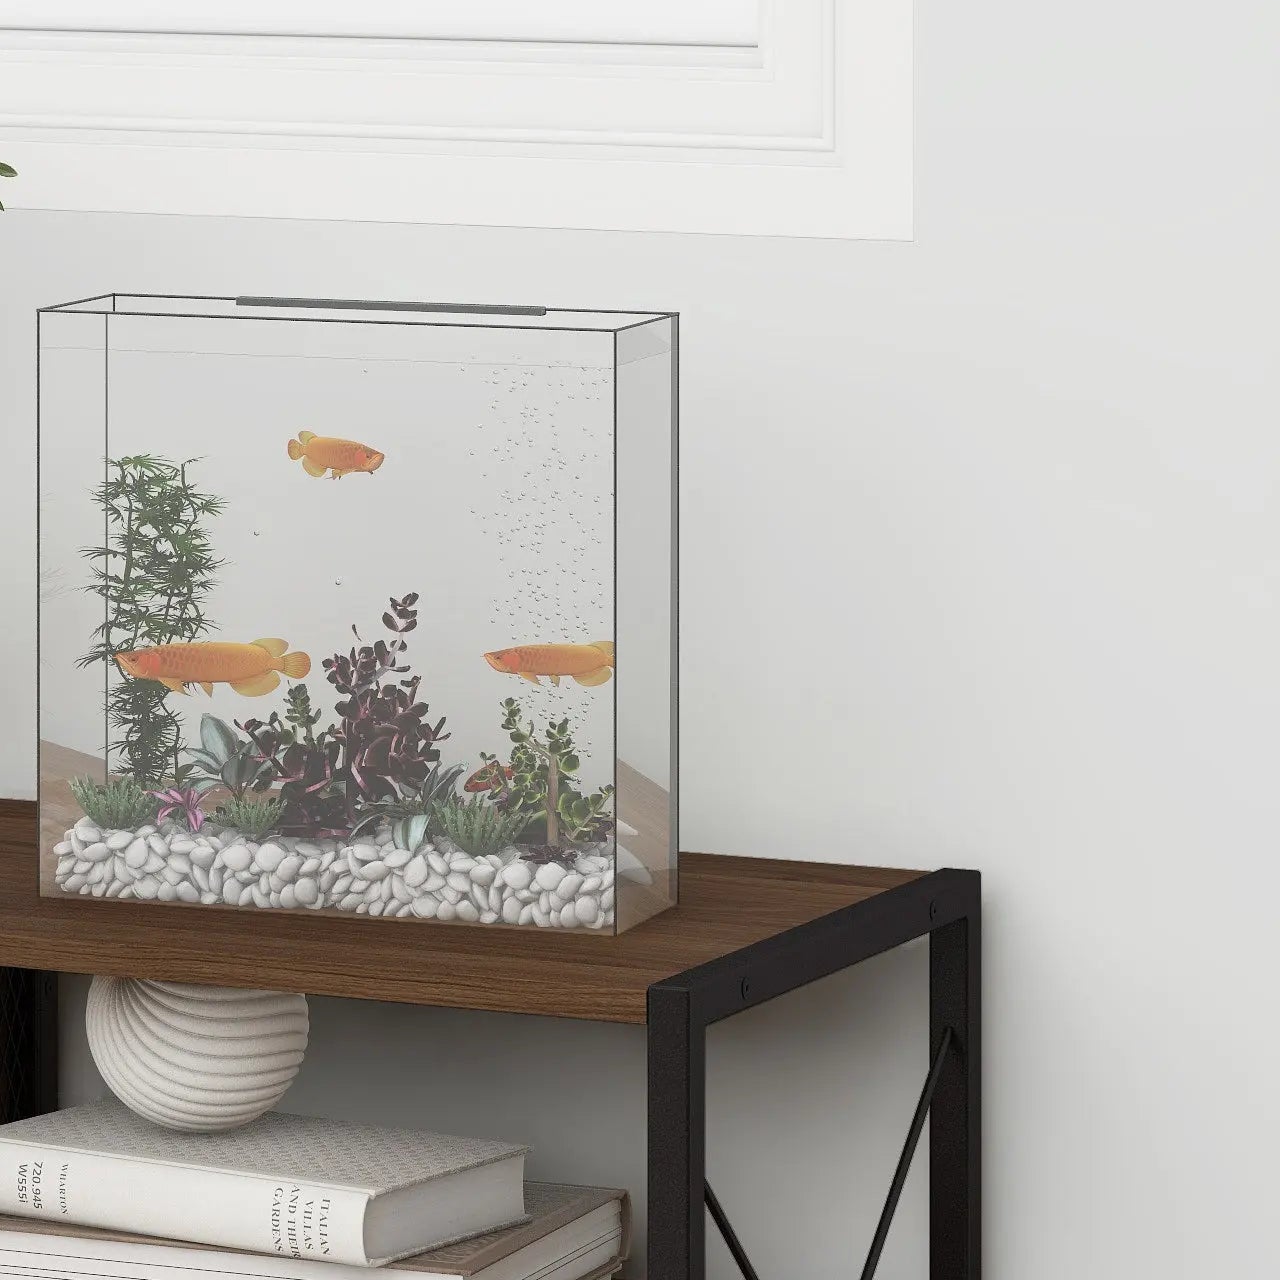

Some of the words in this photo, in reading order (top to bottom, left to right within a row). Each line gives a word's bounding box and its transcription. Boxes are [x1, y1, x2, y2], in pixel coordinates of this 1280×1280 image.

[17, 1163, 28, 1203] W555i
[32, 1161, 44, 1209] 720.945
[59, 1163, 69, 1215] WHARTON
[288, 1185, 300, 1214] AND
[271, 1187, 284, 1252] GARDENS
[287, 1218, 301, 1259] THEIR
[303, 1200, 314, 1250] VILLAS
[319, 1198, 331, 1256] ITALIAN
